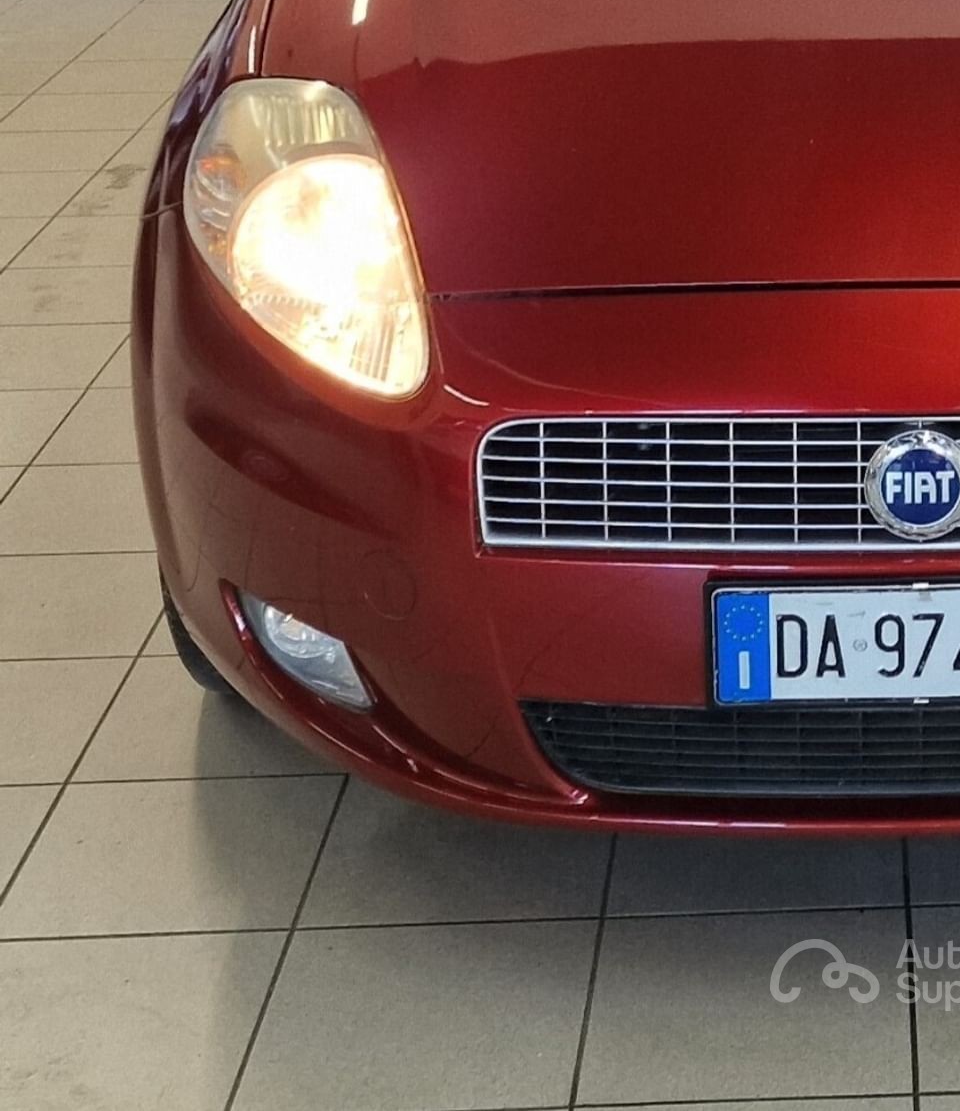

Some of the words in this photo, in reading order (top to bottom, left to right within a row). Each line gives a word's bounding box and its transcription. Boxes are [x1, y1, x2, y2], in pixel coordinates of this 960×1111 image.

[885, 471, 955, 505] FIAT
[738, 650, 751, 690] I
[775, 614, 846, 679] DA
